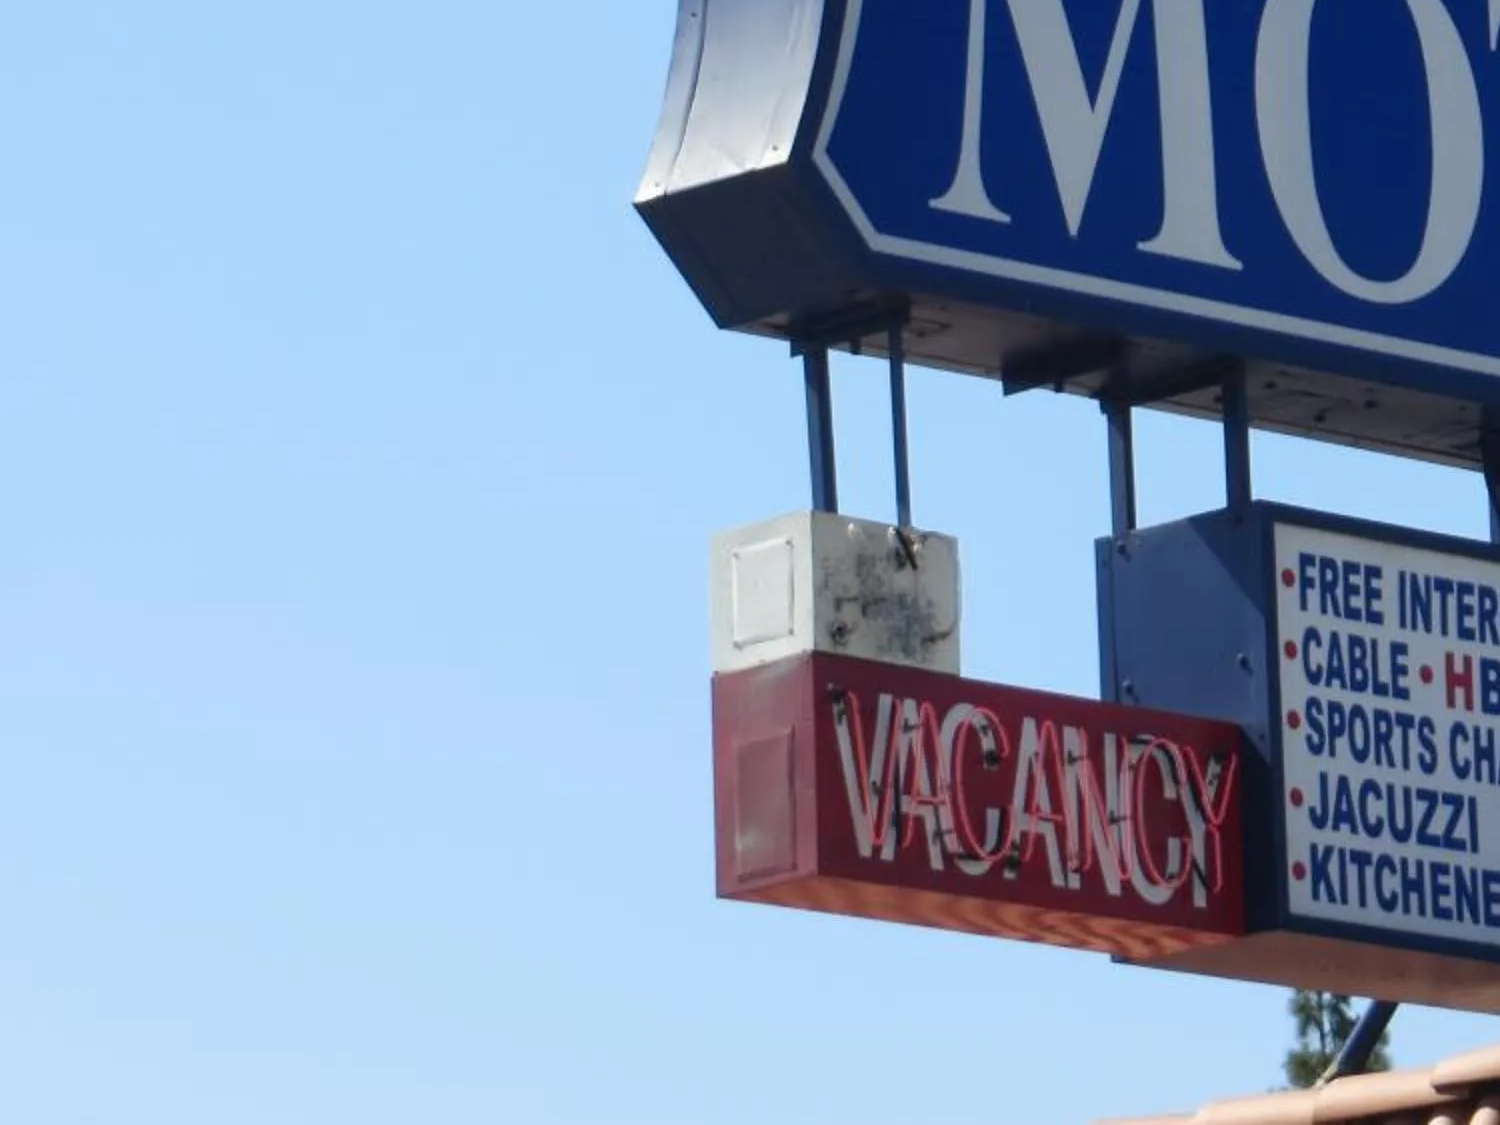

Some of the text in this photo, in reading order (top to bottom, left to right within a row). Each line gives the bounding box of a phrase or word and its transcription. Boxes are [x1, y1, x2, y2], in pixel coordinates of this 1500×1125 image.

[1299, 552, 1385, 626] FREE
[1301, 625, 1411, 701] CABLE
[1304, 695, 1439, 776] SPORTS
[830, 689, 1238, 908] VACANCY
[1308, 771, 1480, 855] JACUZZI
